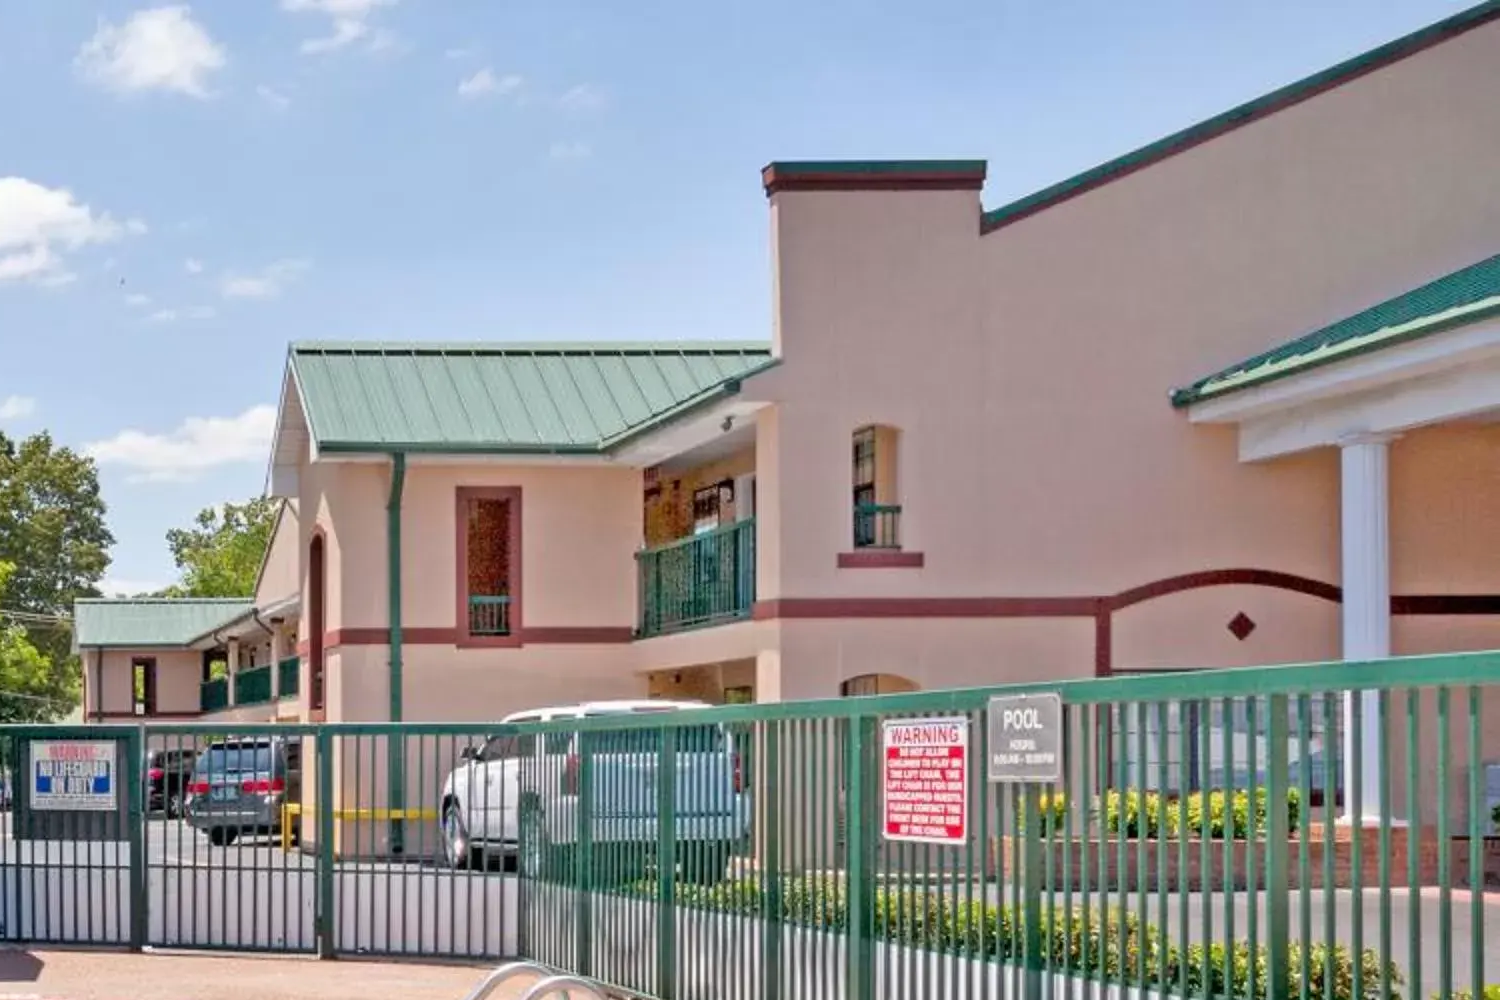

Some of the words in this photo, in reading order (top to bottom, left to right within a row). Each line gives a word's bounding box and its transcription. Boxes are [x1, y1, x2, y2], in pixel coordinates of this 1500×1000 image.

[1003, 708, 1044, 731] POOL
[891, 725, 960, 744] WARNING
[39, 760, 53, 777] NO
[55, 760, 106, 777] LIFEGUARD
[51, 776, 65, 793] ON
[67, 776, 95, 793] DUTY
